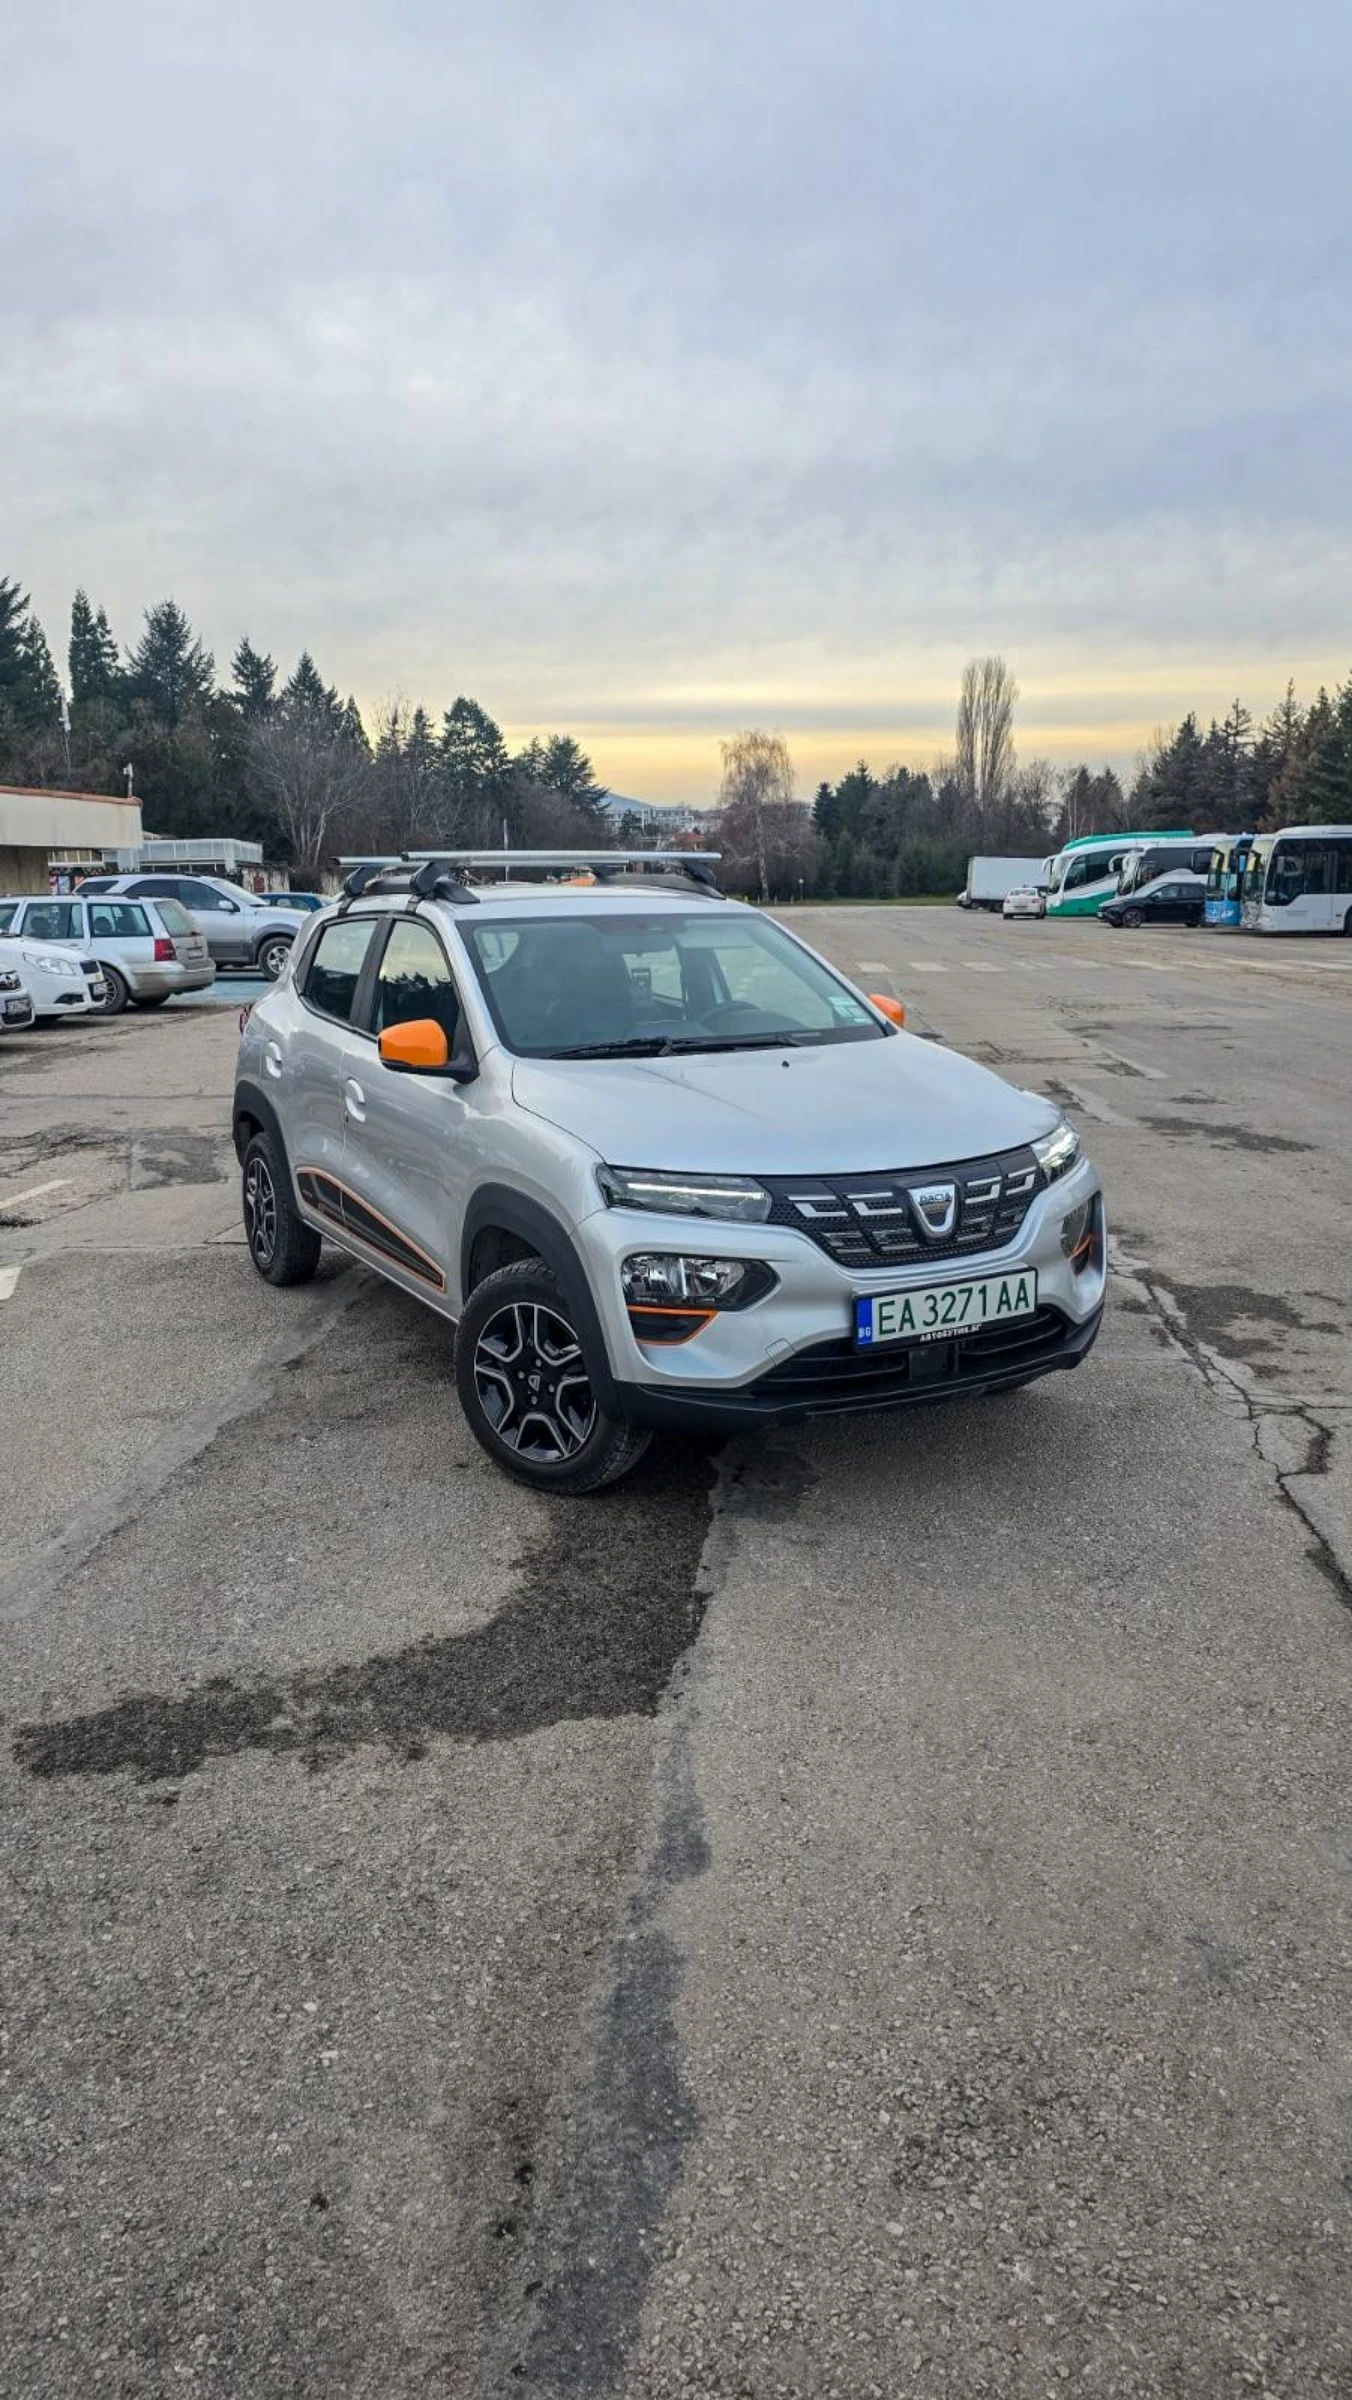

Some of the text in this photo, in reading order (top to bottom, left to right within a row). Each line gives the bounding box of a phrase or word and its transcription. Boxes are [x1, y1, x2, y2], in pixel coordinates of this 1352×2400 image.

[919, 1192, 952, 1204] DACIA
[879, 1278, 1030, 1336] EA 3271 AA
[858, 1327, 871, 1338] BG
